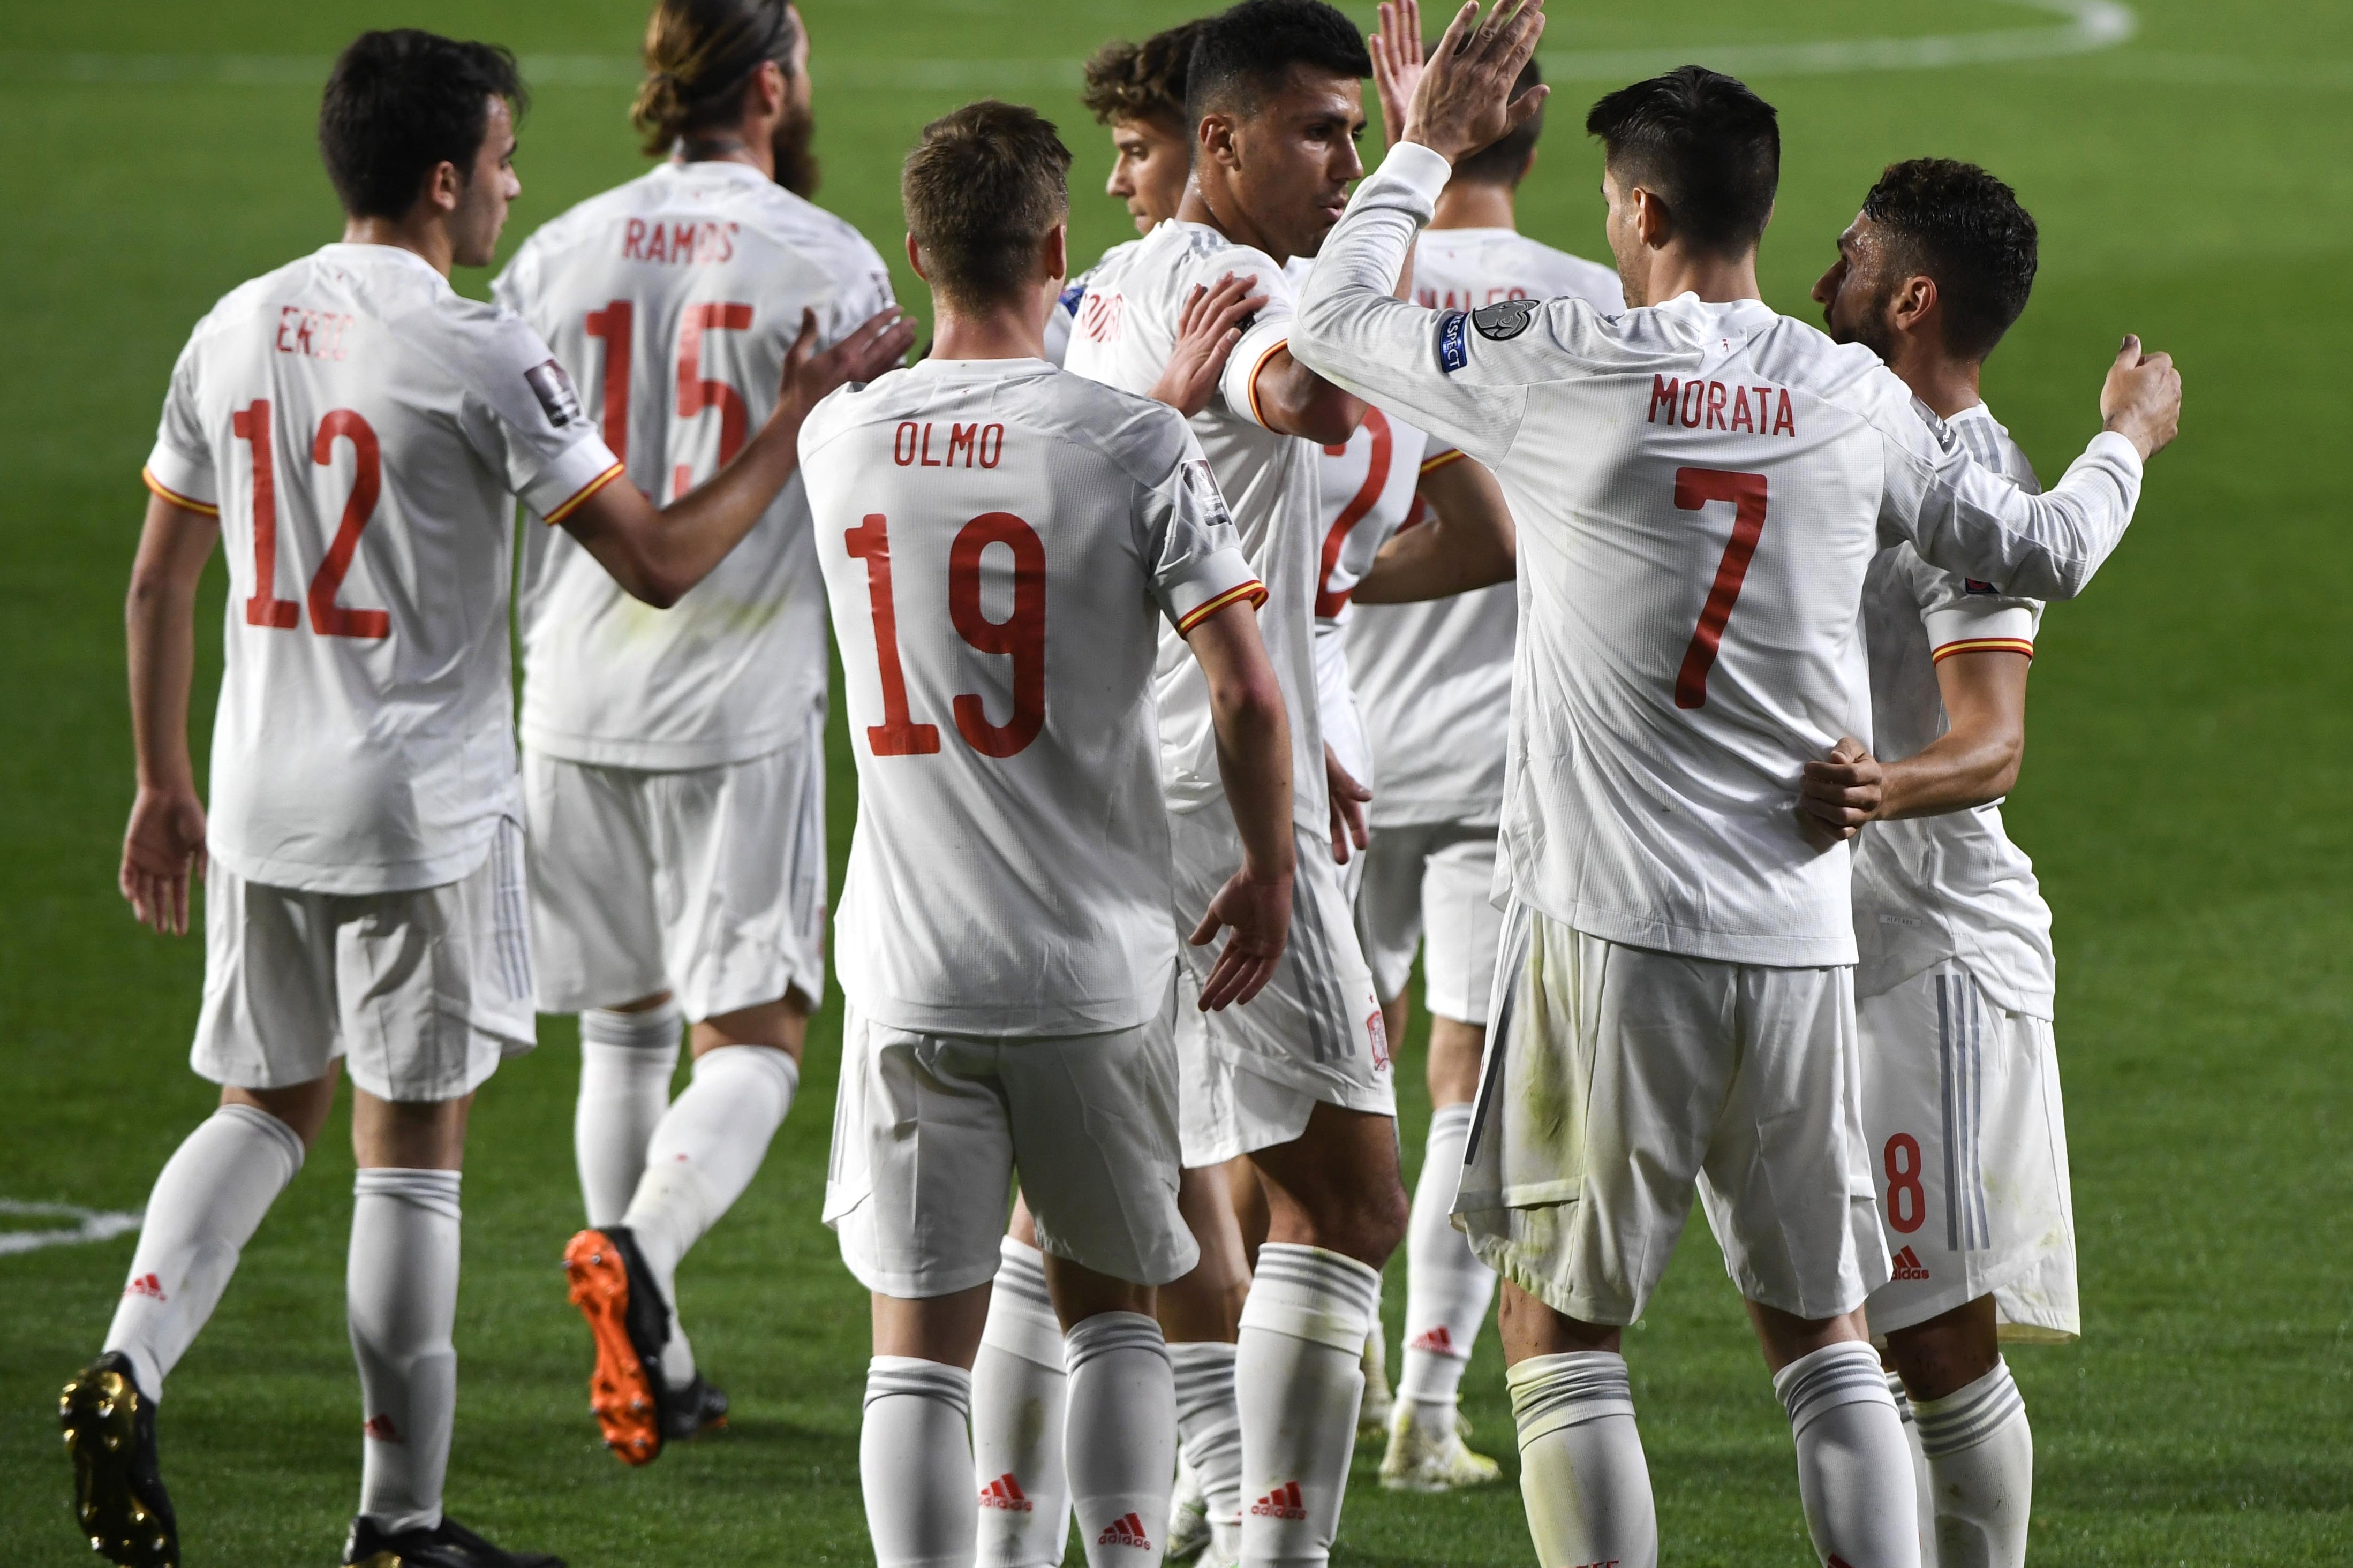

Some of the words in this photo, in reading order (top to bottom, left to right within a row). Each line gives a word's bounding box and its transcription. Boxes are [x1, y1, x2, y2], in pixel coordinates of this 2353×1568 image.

[623, 218, 740, 264] RAMOS
[276, 305, 354, 362] ERIC
[585, 300, 753, 500] 15
[1648, 374, 1796, 438] MORATA
[894, 421, 1005, 469] OLMO
[232, 399, 390, 639] 12
[1674, 467, 1768, 709] 7
[844, 512, 1046, 758] 19
[1884, 1132, 1926, 1233] 8
[1891, 1266, 1930, 1281] didas
[1098, 1532, 1151, 1551] adidas
[1251, 1505, 1307, 1520] adidas
